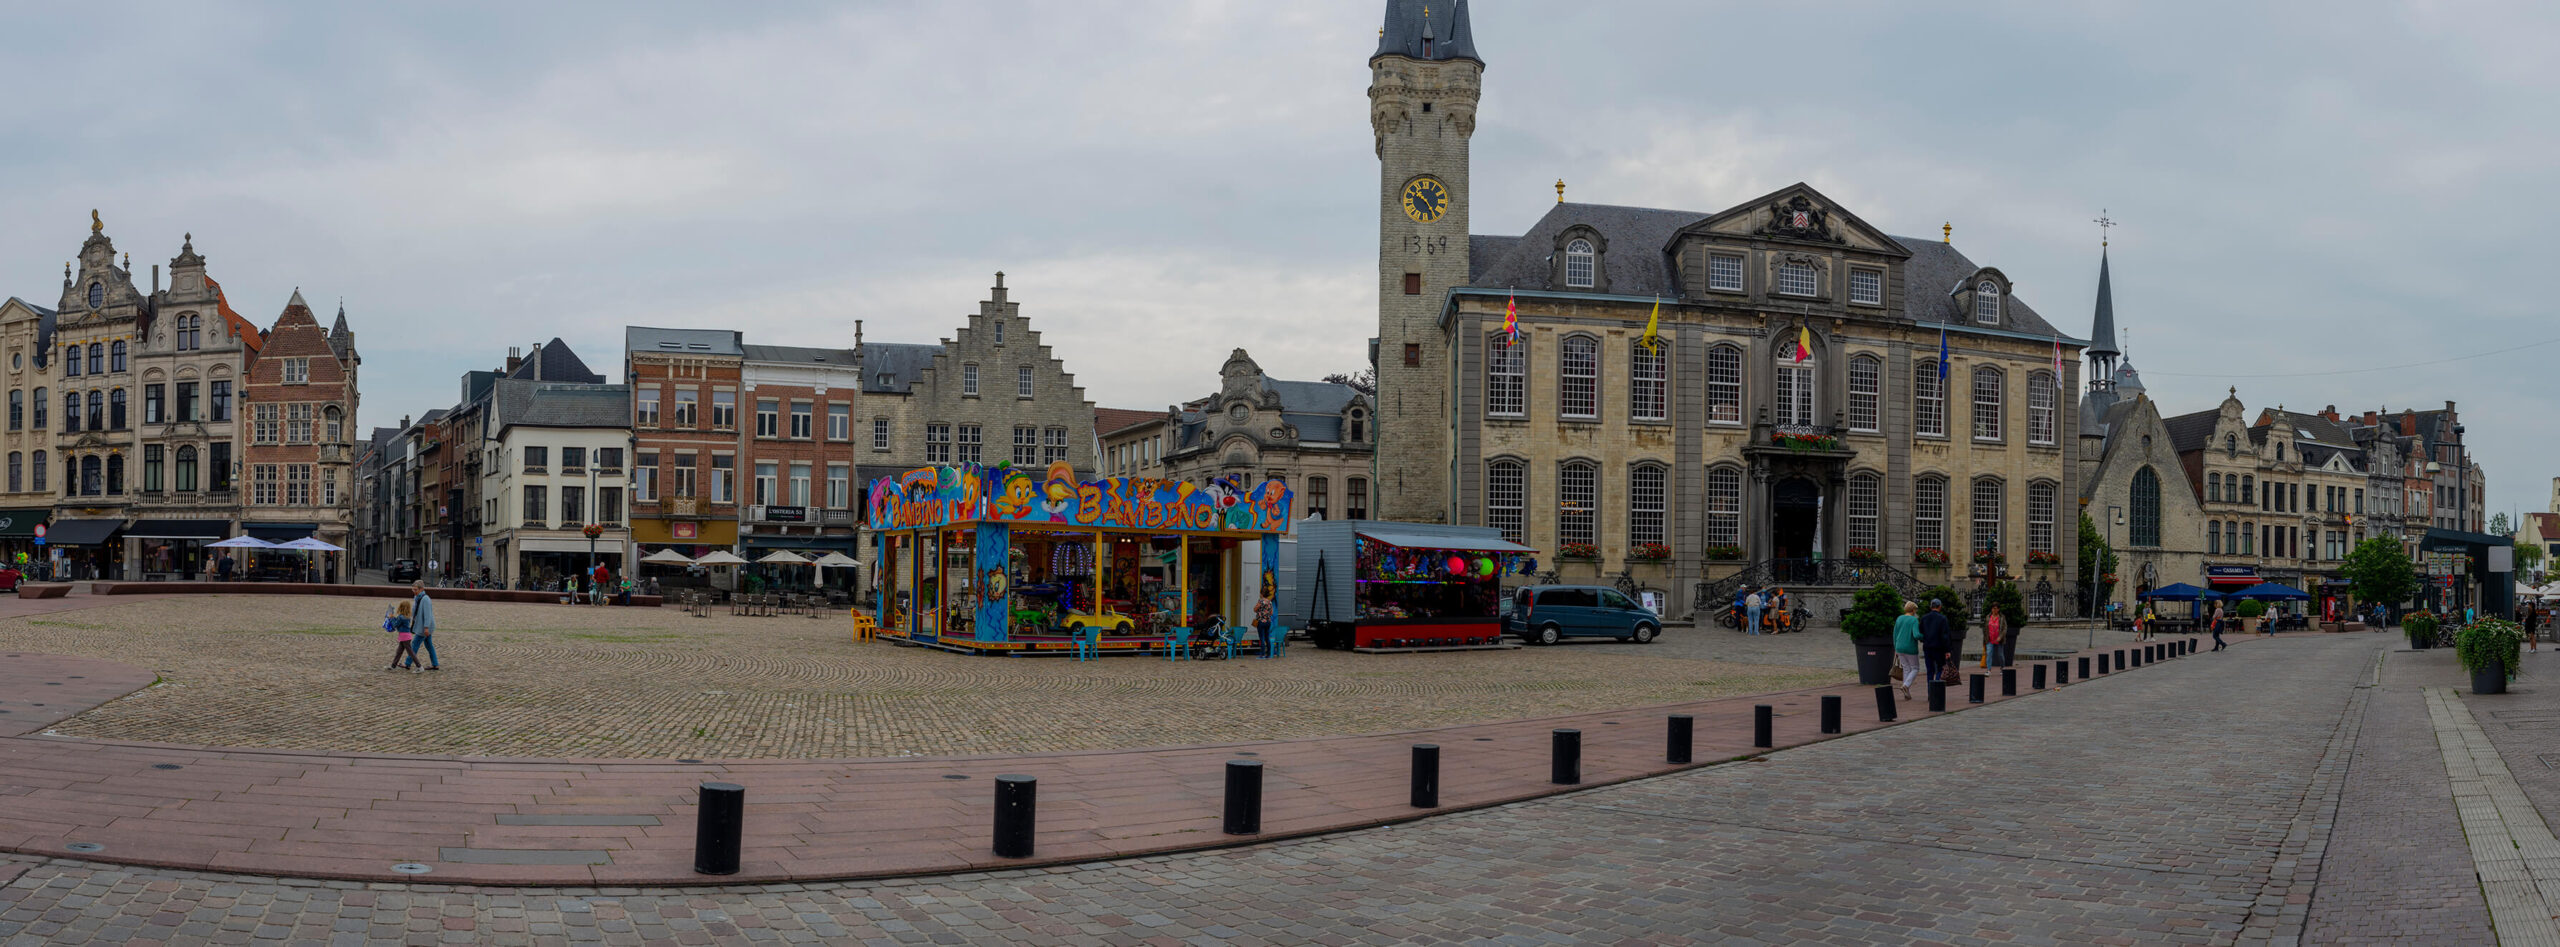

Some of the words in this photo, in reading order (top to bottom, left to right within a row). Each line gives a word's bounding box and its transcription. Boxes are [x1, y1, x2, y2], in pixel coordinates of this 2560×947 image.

[1404, 235, 1447, 255] 1369
[891, 494, 944, 529] BAMBINO
[1075, 484, 1213, 530] BAMBINO
